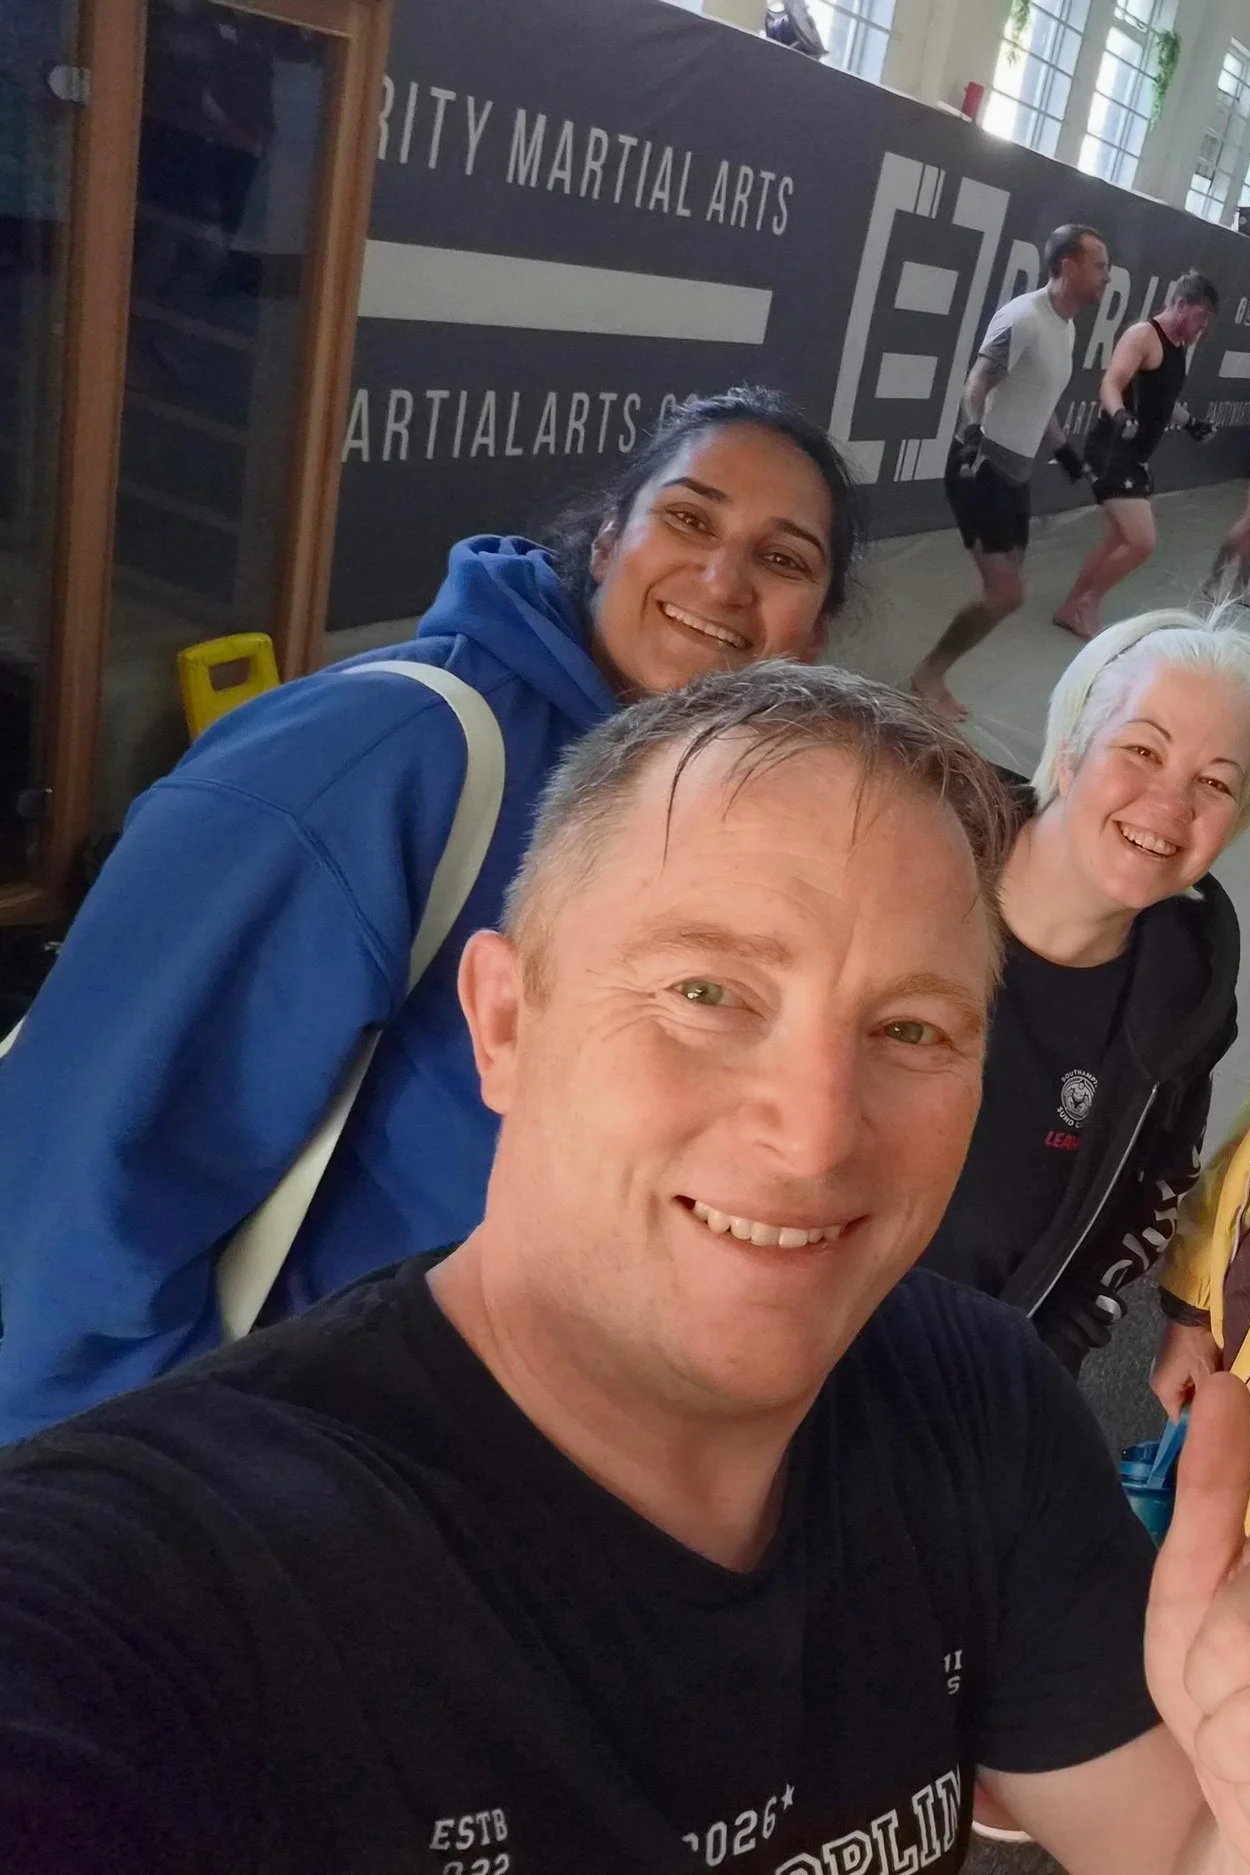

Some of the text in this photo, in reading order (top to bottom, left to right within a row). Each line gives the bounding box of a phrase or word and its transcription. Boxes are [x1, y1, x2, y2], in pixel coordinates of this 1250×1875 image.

[506, 107, 692, 218] MARTIAL
[706, 160, 794, 236] ARTS
[1056, 1106, 1075, 1127] SUMO
[429, 1808, 508, 1851] ESTB
